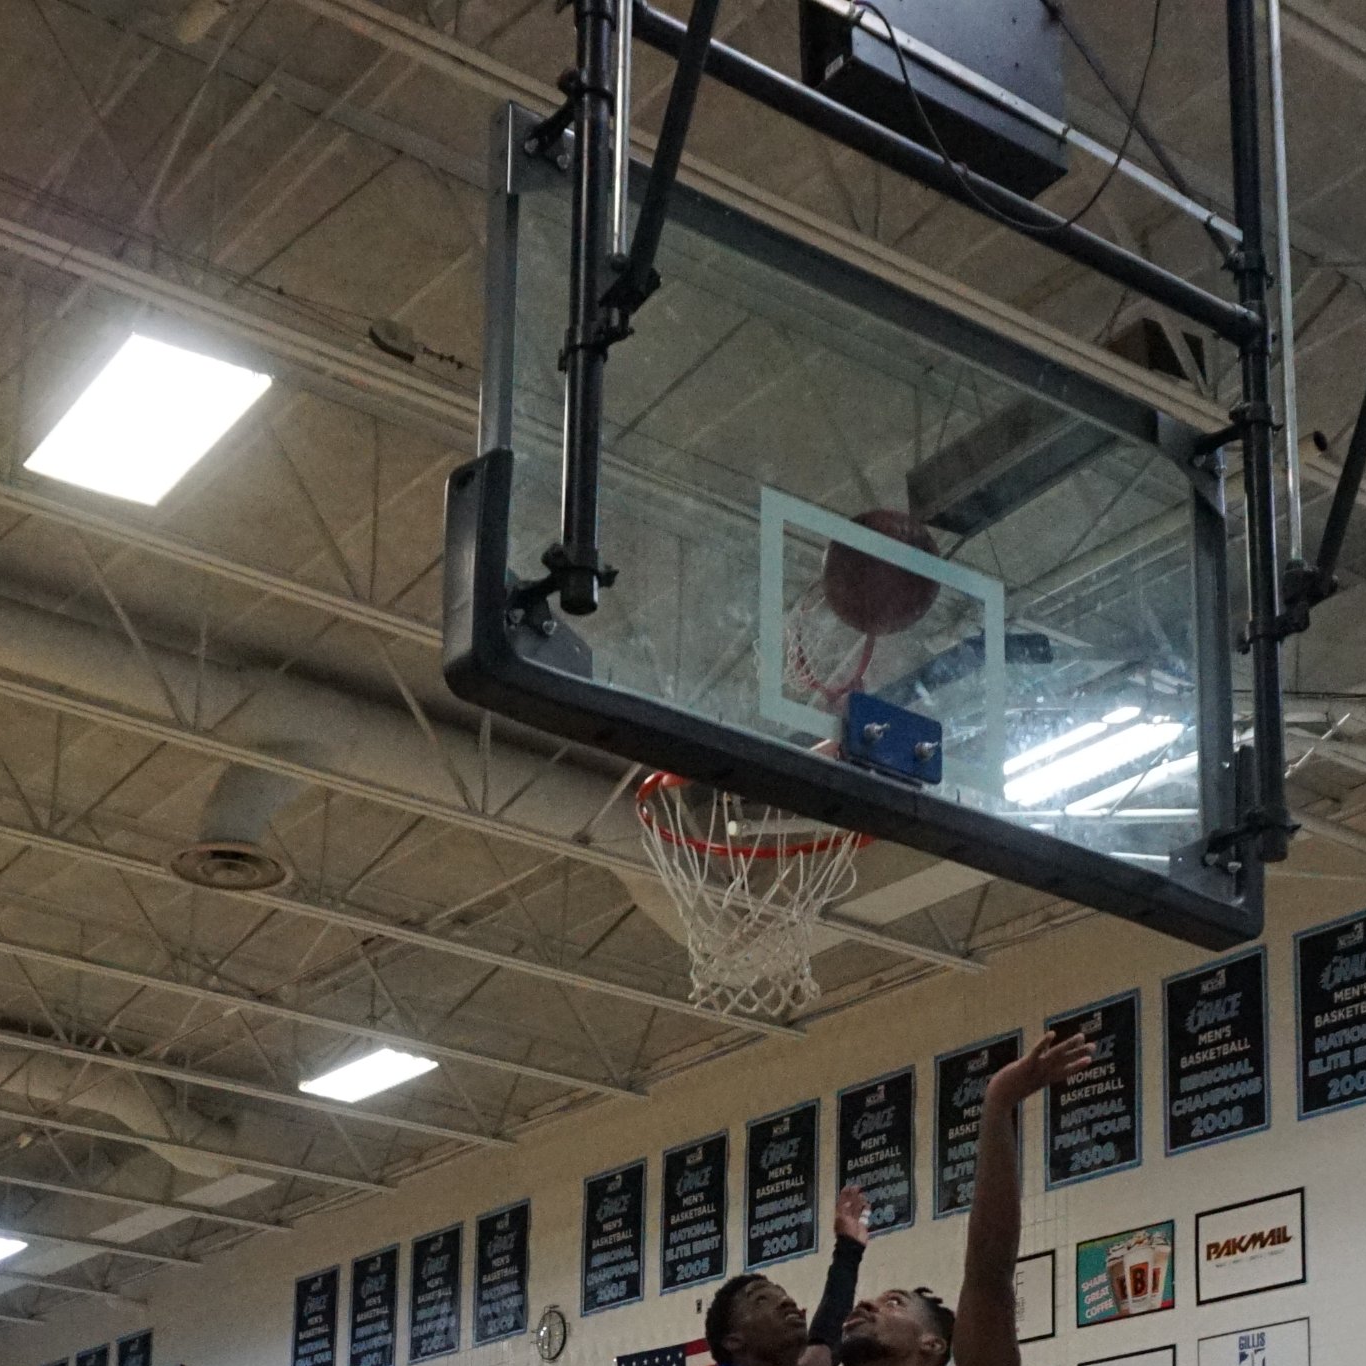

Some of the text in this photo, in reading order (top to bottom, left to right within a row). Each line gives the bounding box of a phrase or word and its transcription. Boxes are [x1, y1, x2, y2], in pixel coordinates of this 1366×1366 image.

[1197, 1024, 1230, 1047] MEN'S
[1180, 1035, 1250, 1070] BASKETBALL
[1066, 1061, 1115, 1088] WOMEN'S
[1060, 1075, 1123, 1106] BASKETBALL
[1172, 1075, 1261, 1117] CHAMPIONS
[861, 1132, 886, 1151] MEN'S
[847, 1142, 901, 1171] BASKETBALL
[768, 1163, 792, 1181] MEN'S
[756, 1174, 804, 1199] BASKETBALL
[670, 1201, 716, 1225] BASKETBALL
[591, 1227, 633, 1249] BASKETBALL
[1239, 1332, 1266, 1350] GILLIS
